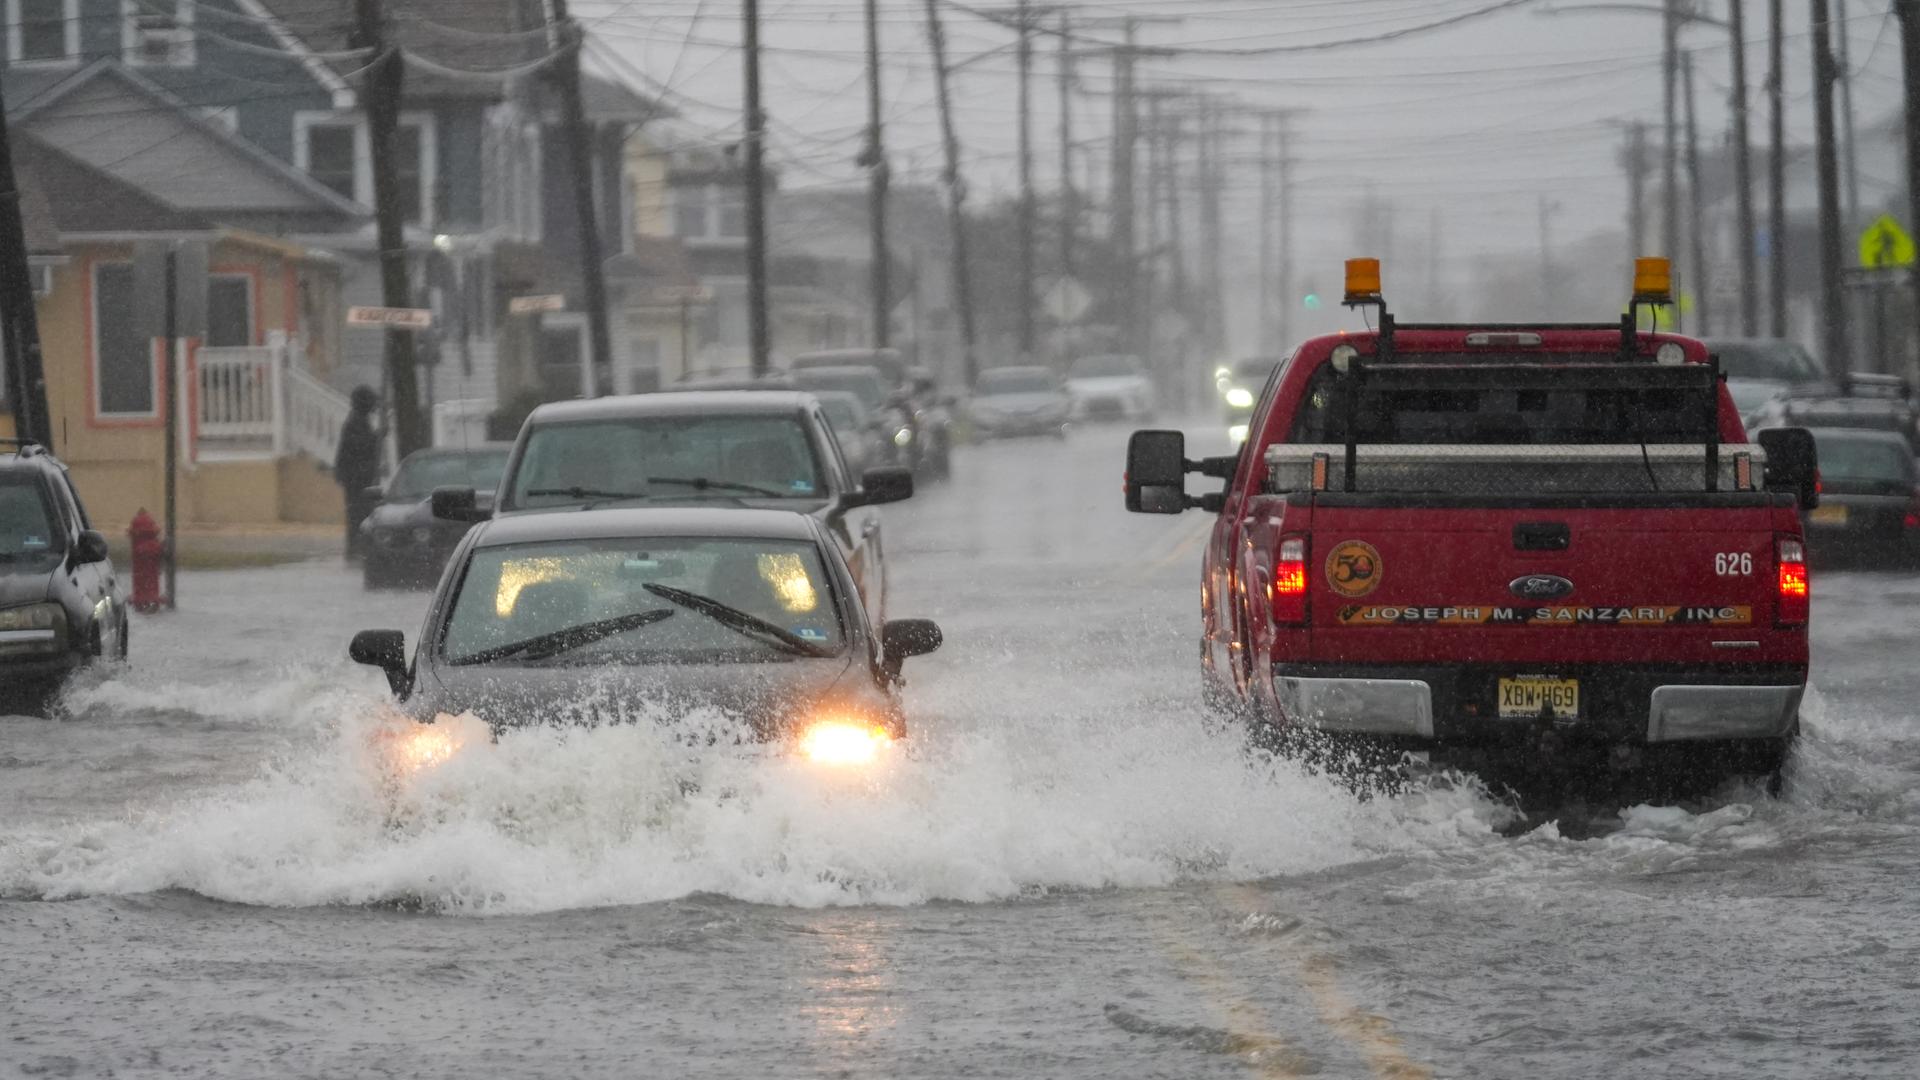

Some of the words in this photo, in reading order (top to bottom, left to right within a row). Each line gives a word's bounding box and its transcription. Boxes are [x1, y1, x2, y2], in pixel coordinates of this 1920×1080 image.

[1715, 552, 1752, 575] 626
[1523, 577, 1561, 594] Ford
[1364, 607, 1480, 620] JOSEPH
[1492, 607, 1523, 620] M.
[1535, 607, 1673, 621] SANZARI,
[1686, 607, 1746, 620] INC.
